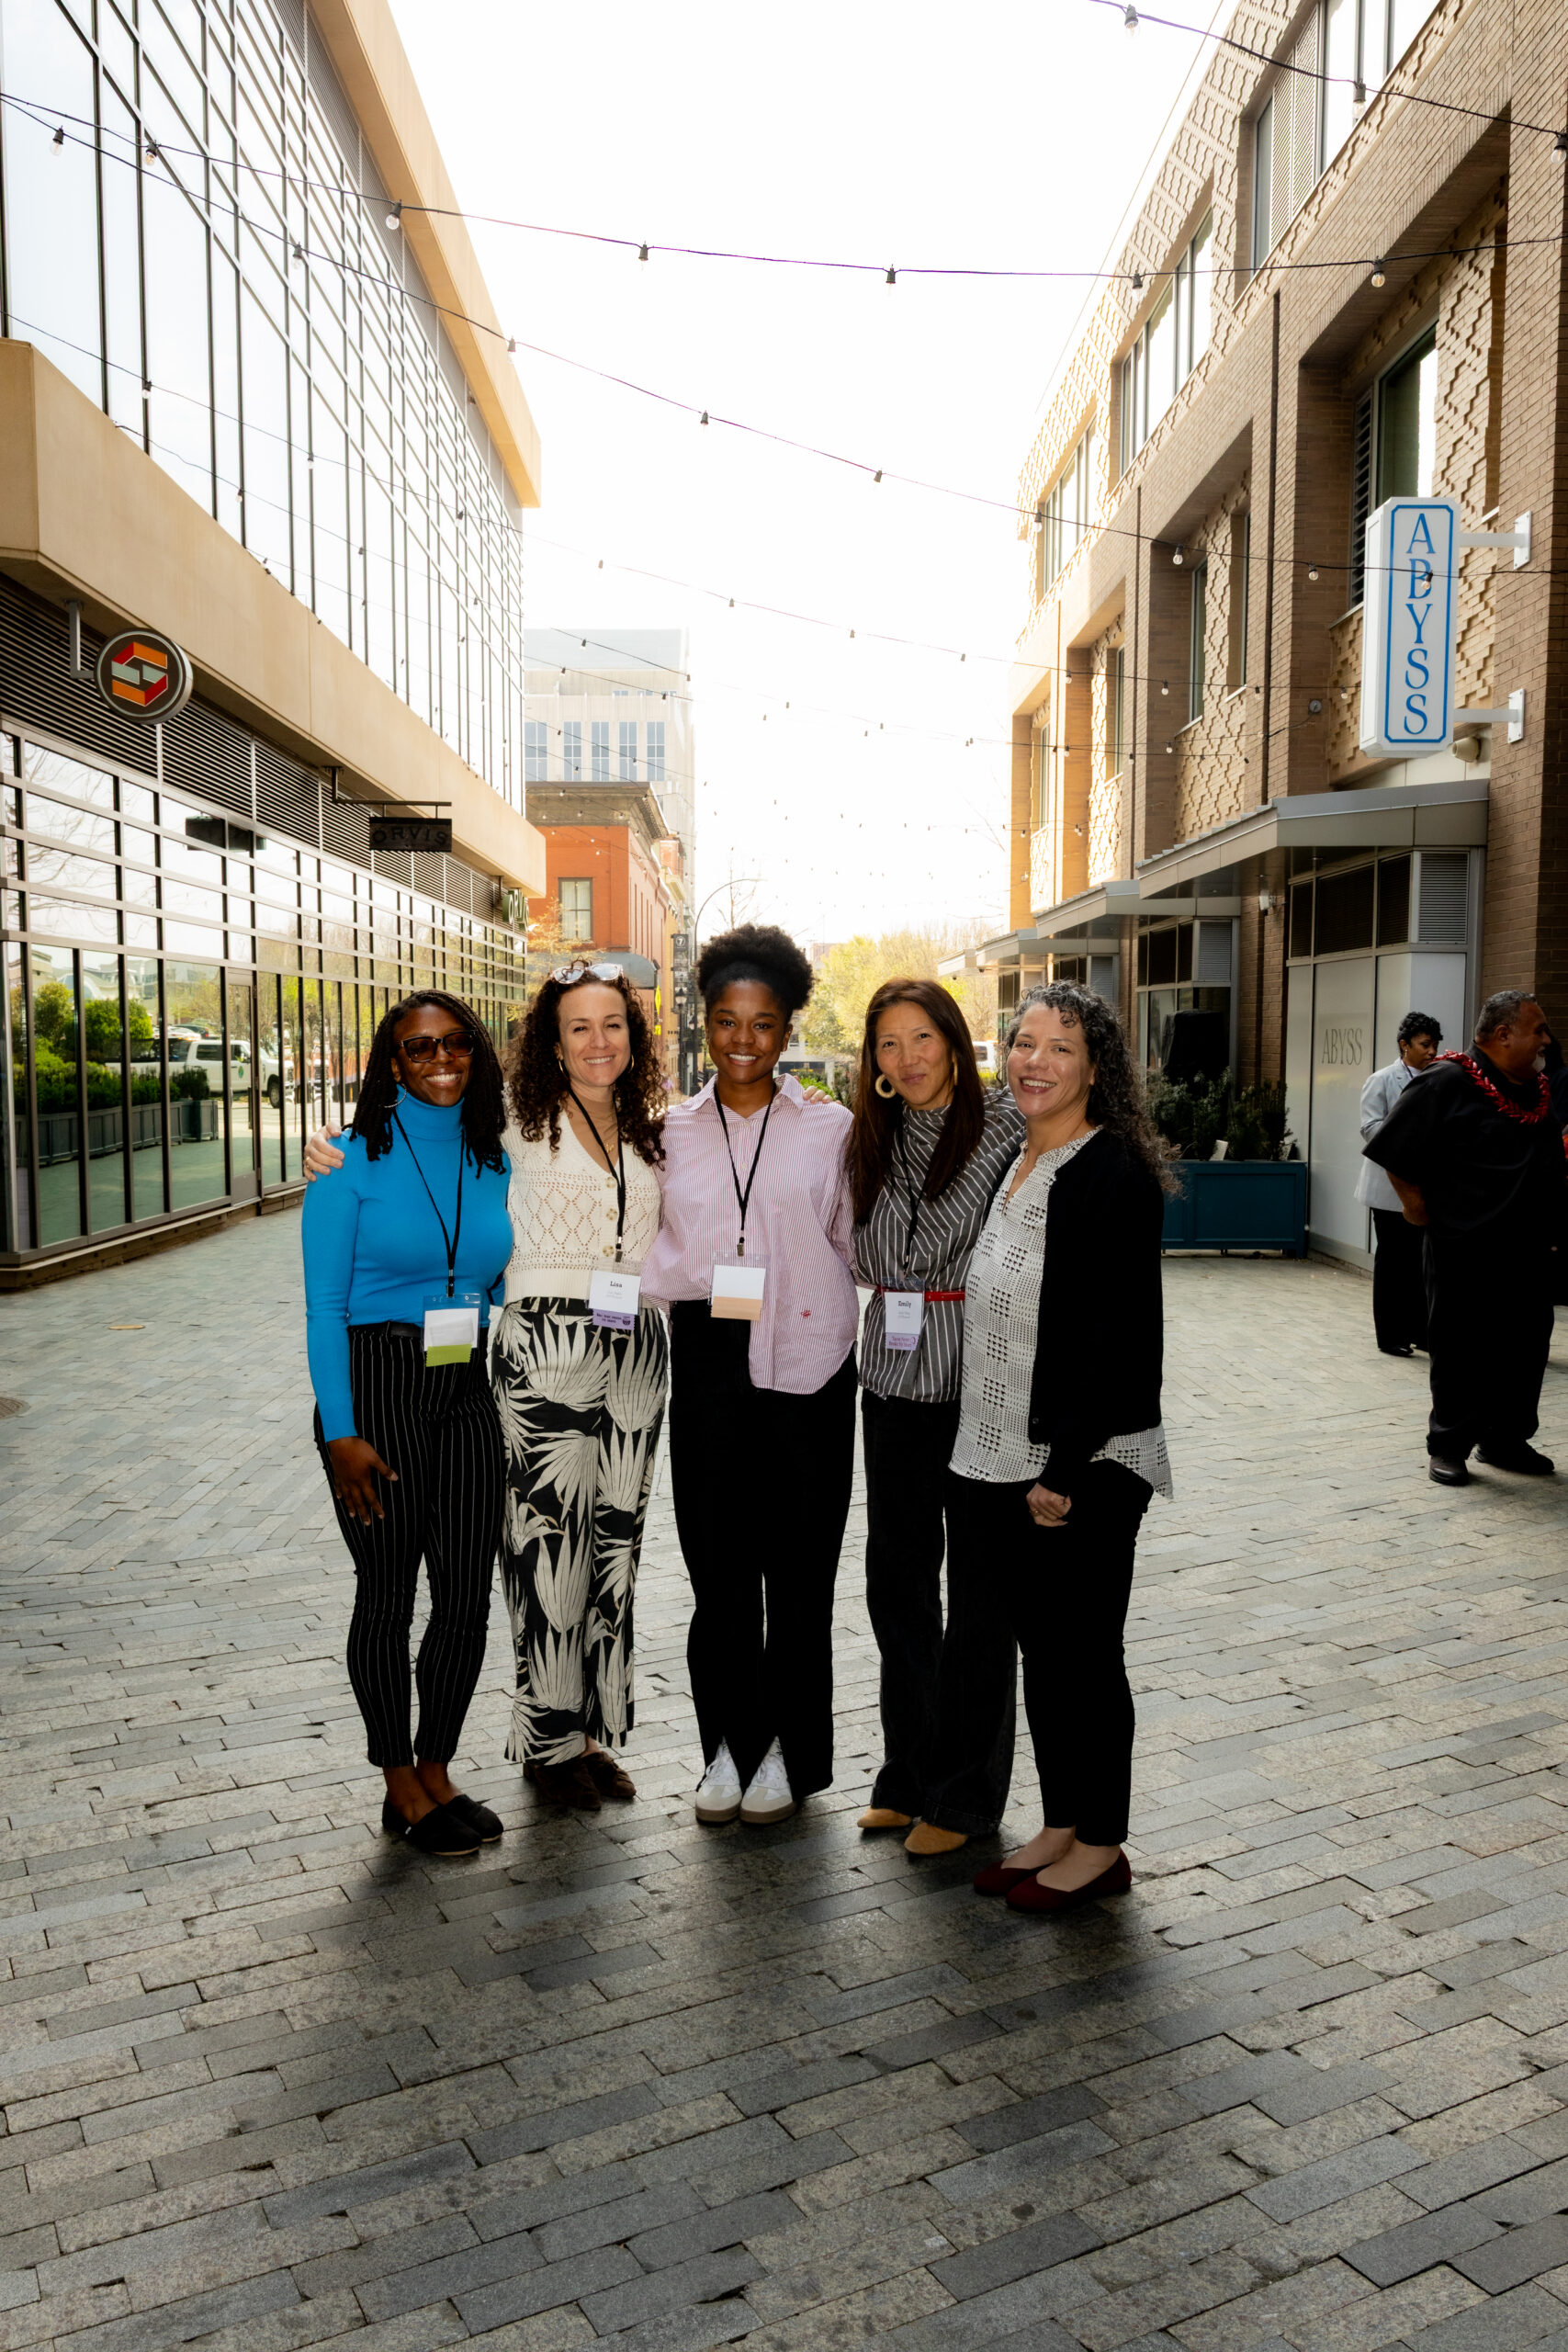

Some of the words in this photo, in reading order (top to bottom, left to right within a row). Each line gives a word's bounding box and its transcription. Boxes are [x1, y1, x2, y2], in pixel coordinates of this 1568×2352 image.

[1403, 513, 1437, 736] ABYSS
[372, 826, 448, 846] ORVIS
[1321, 1027, 1363, 1066] ABYSS
[897, 1300, 912, 1308] Emily
